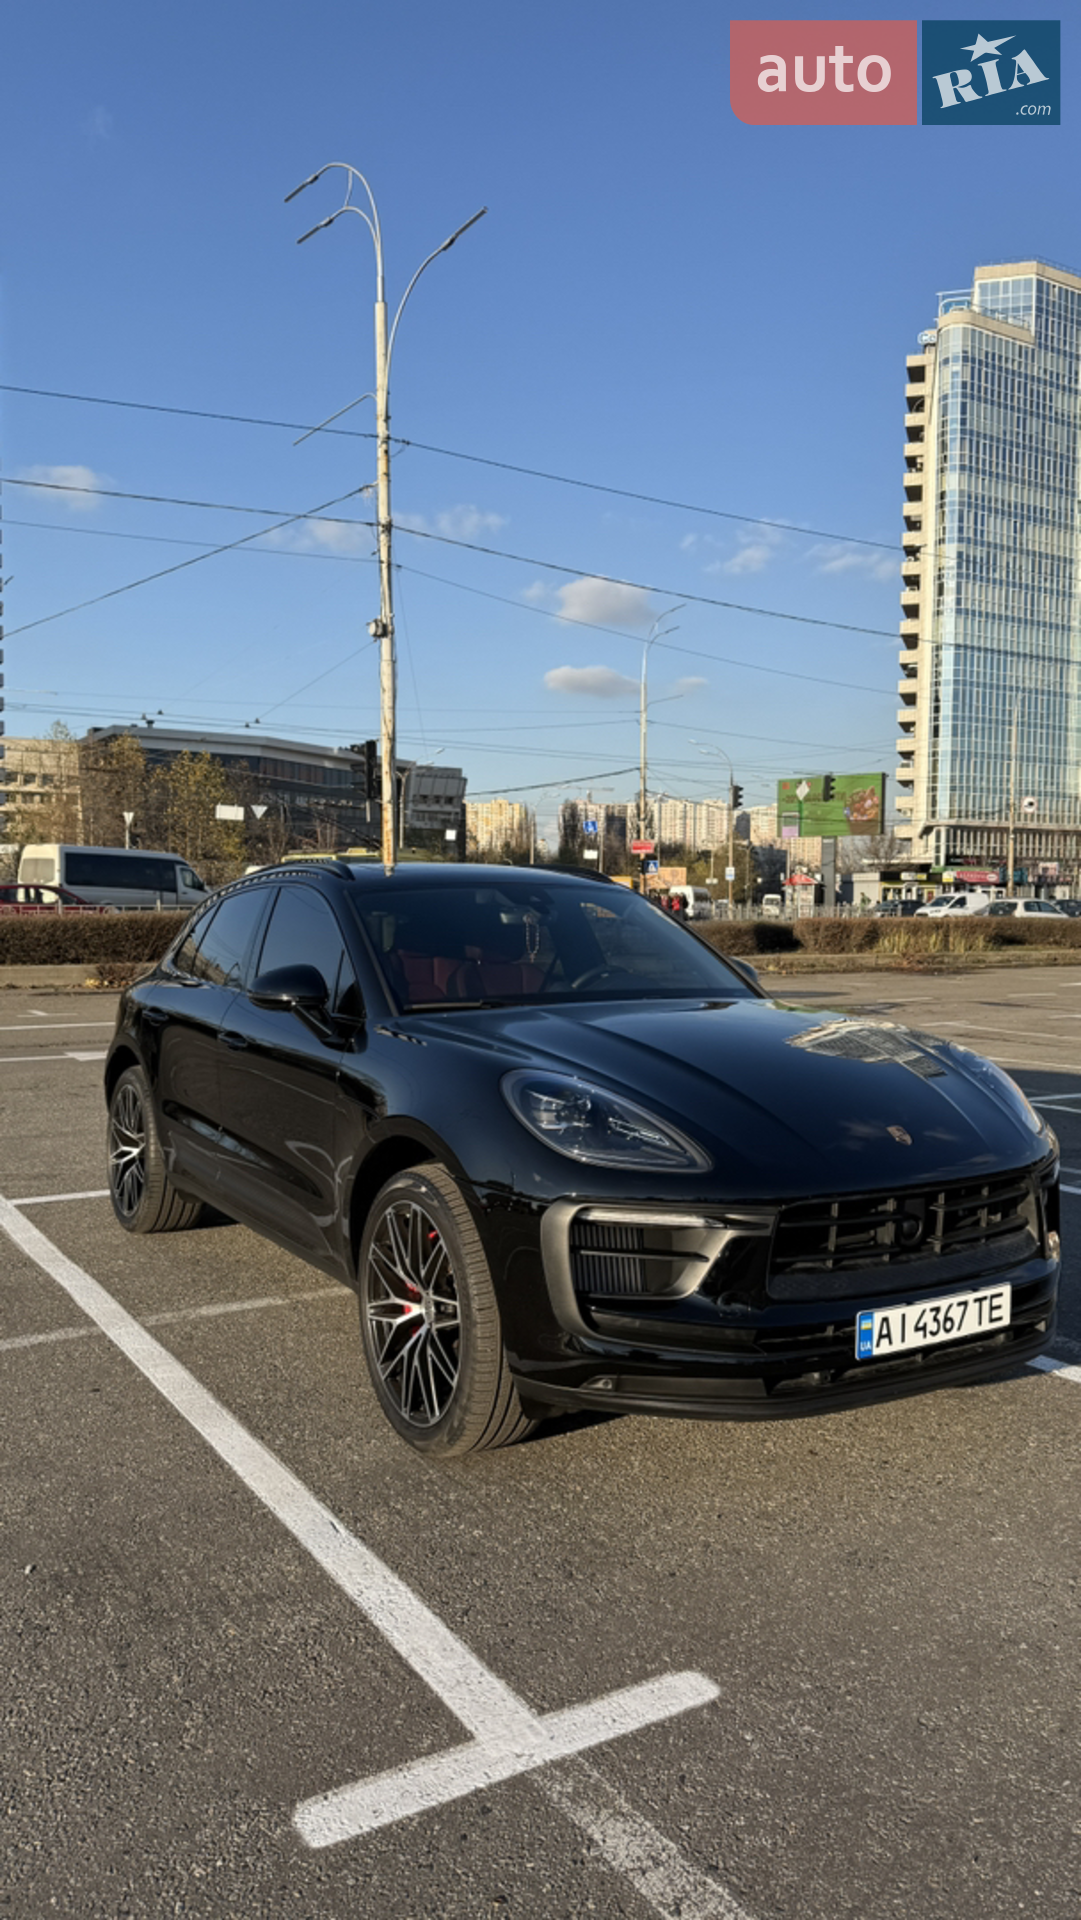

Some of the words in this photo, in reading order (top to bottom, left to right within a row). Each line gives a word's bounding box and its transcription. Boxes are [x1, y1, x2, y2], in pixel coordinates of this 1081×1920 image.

[875, 1313, 906, 1348] AI
[913, 1299, 969, 1339] 4367
[973, 1292, 1004, 1327] TE
[860, 1341, 872, 1352] UA
